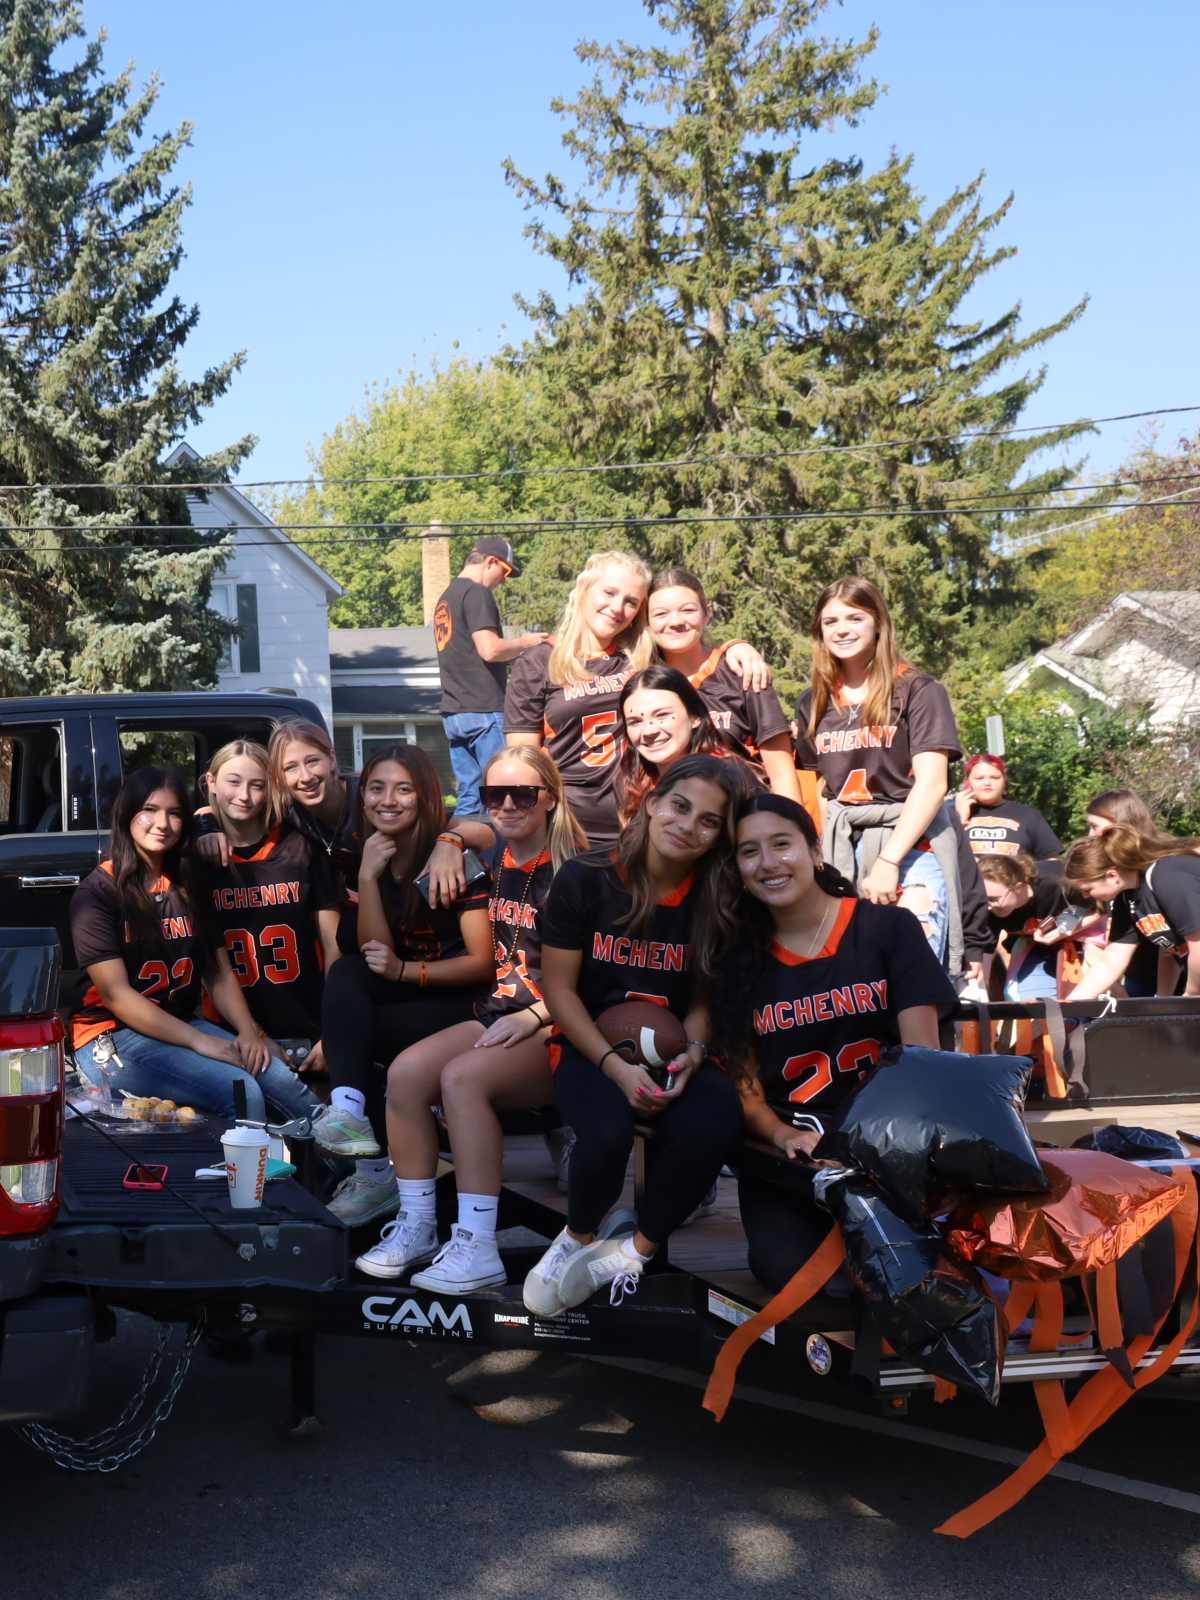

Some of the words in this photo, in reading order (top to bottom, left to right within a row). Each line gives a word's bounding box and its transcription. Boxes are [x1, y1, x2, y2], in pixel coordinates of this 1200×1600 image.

[581, 711, 627, 767] 5
[223, 924, 300, 988] 33
[753, 979, 888, 1036] MCHENRY
[361, 1295, 473, 1332] CAM
[363, 1322, 473, 1339] SUPERLINE
[494, 1313, 529, 1325] KNAPHEIDE
